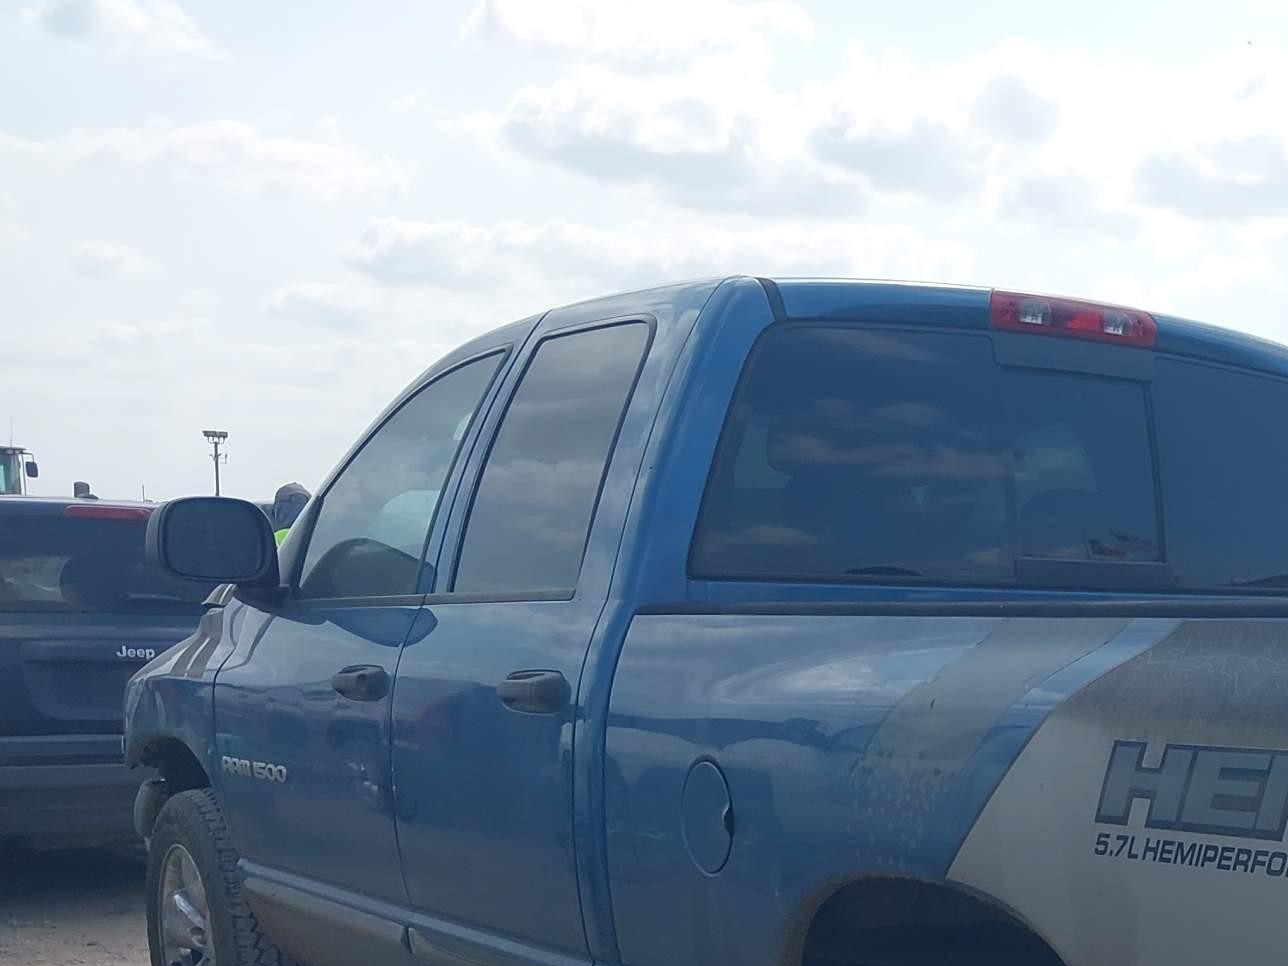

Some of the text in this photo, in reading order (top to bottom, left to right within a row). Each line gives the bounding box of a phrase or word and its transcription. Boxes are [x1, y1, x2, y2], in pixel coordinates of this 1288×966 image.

[115, 645, 156, 660] Jeep
[222, 755, 287, 783] RAM 1500
[1094, 832, 1139, 860] 5.7L
